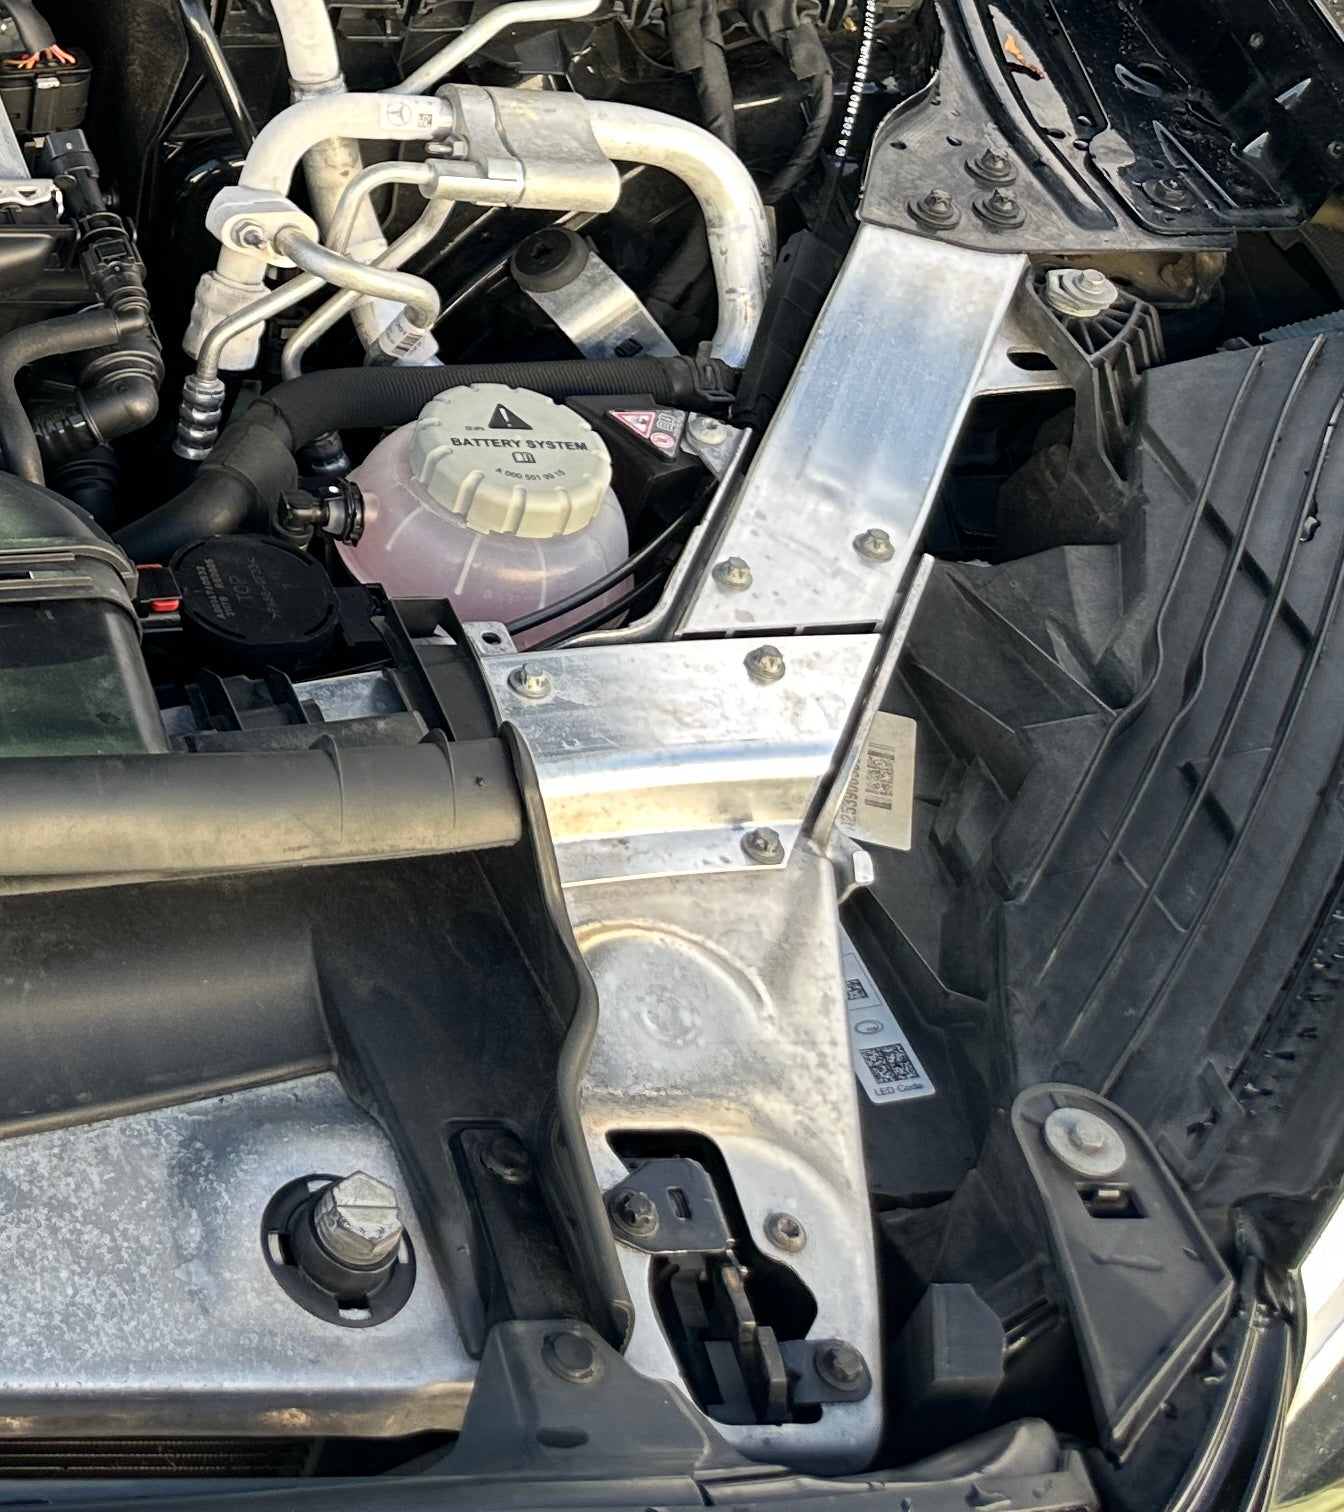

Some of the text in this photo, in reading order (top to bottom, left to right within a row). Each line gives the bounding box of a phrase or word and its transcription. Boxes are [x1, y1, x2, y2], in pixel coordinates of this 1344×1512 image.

[840, 115, 855, 137] 205
[450, 437, 588, 452] BATTERY SYSTEM
[504, 470, 523, 479] 000
[874, 1083, 924, 1096] LED Code
